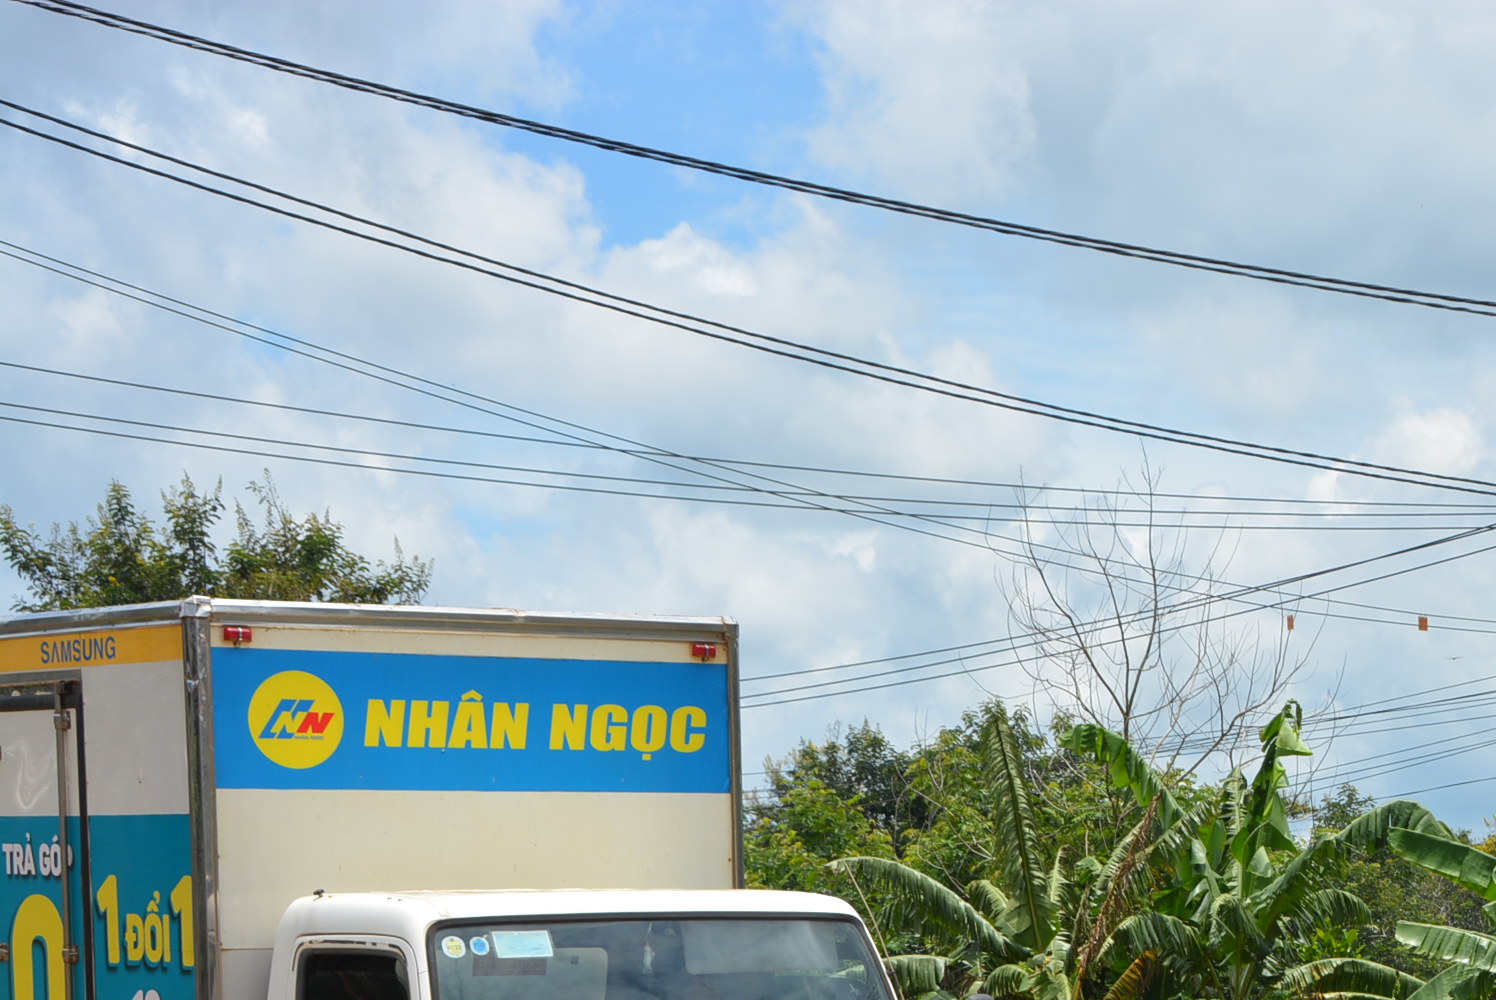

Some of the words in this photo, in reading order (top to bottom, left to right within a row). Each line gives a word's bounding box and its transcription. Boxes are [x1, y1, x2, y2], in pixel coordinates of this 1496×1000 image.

[41, 636, 116, 664] SAMSUNG
[364, 689, 529, 750] NHÂN
[549, 703, 707, 760] NGỌC
[2, 832, 36, 876] TRẢ
[125, 890, 171, 963] ĐỔI
